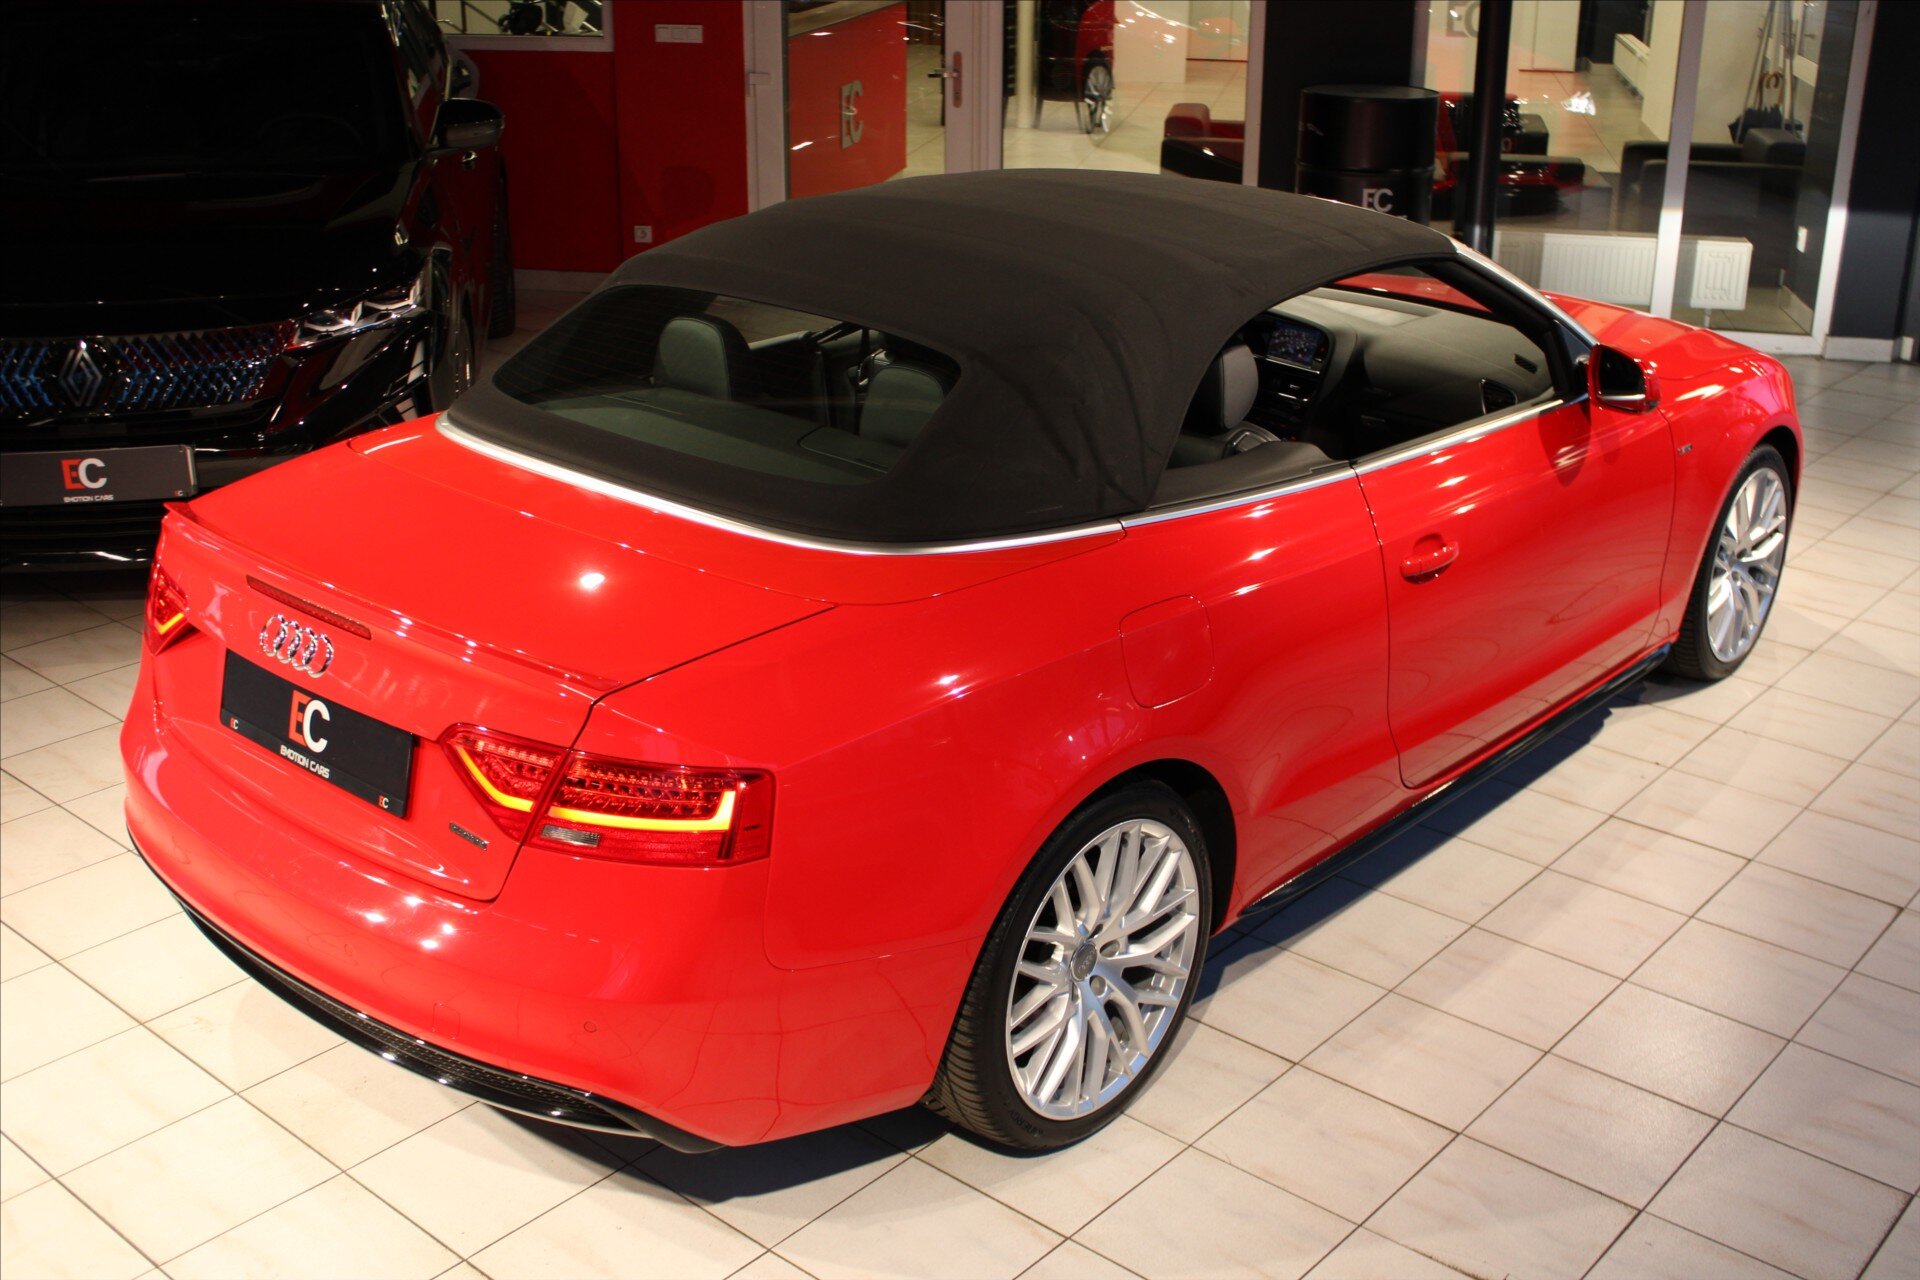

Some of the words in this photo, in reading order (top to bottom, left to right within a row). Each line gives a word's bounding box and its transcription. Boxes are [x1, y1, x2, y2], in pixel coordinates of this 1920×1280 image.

[61, 458, 107, 489] EC
[94, 494, 114, 502] CARS
[288, 690, 331, 753] EC
[280, 744, 310, 769] EMOTION
[309, 760, 330, 779] CARS
